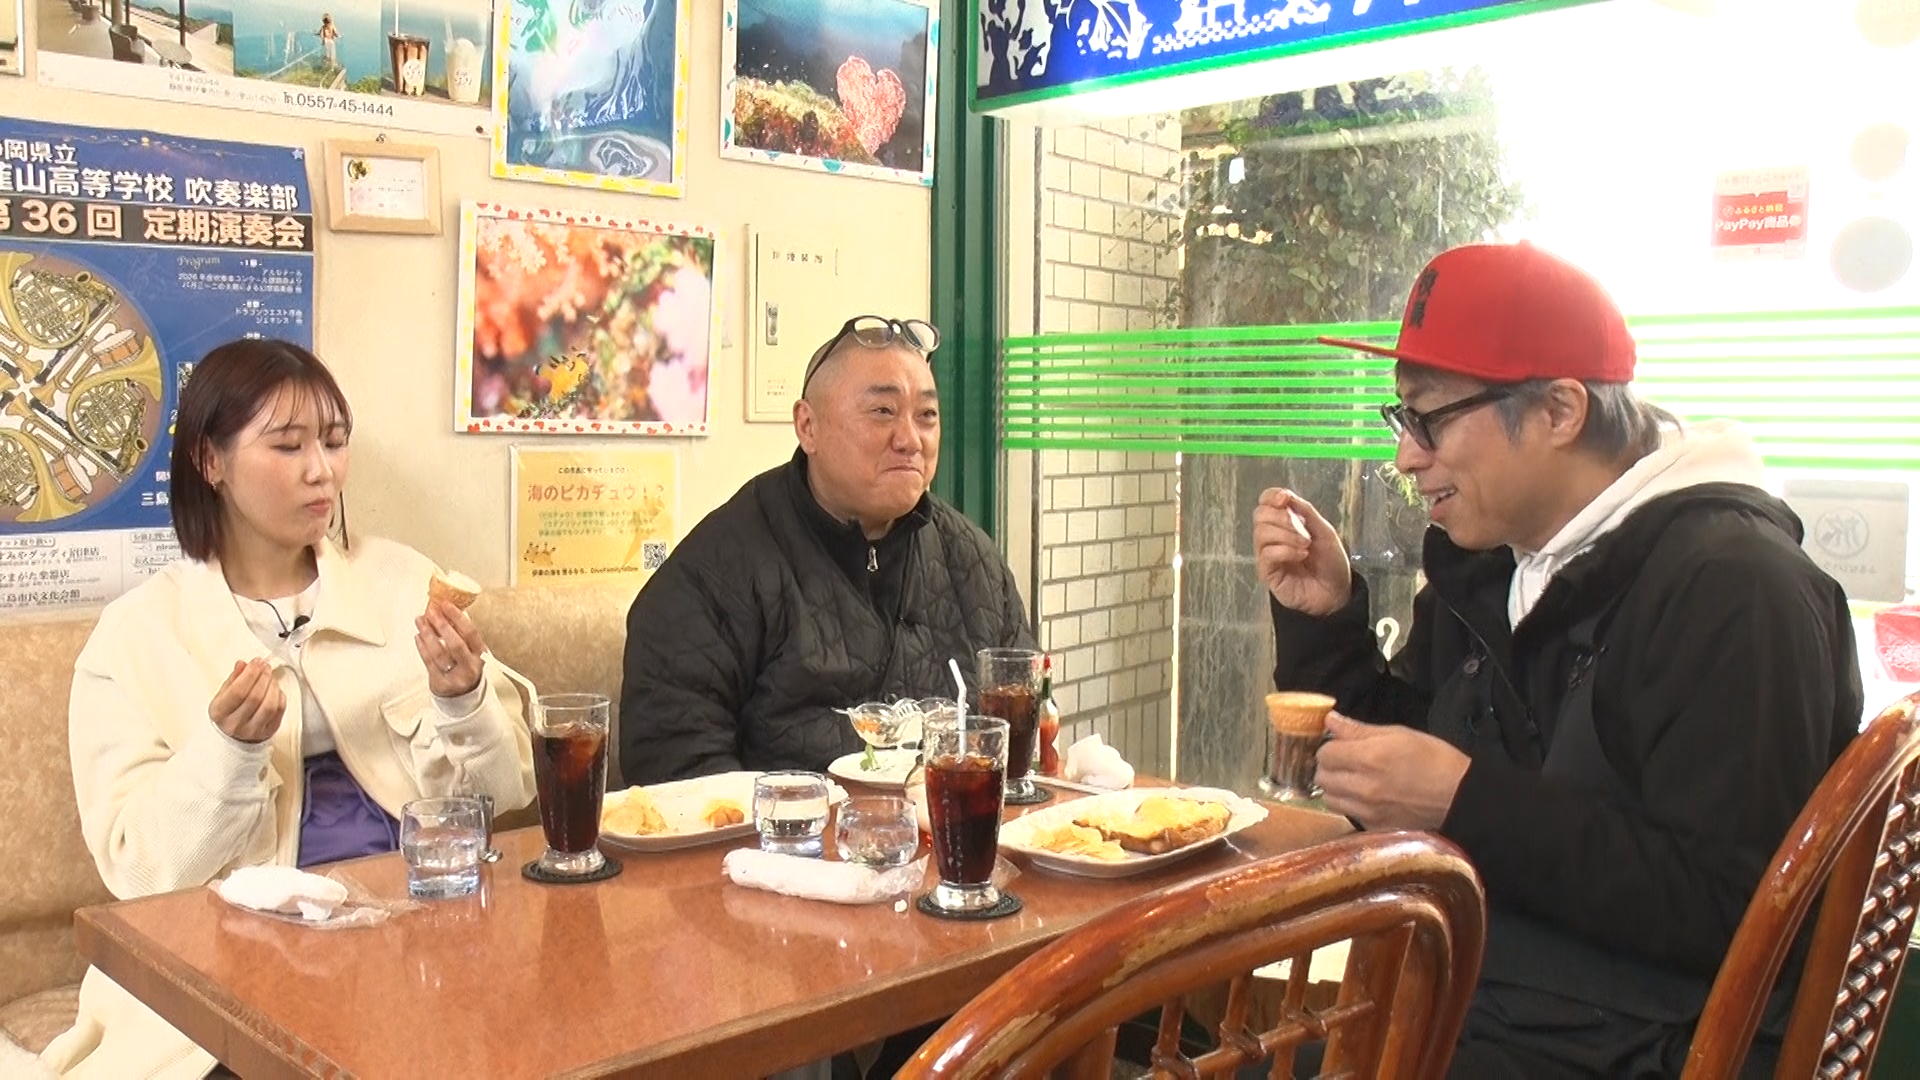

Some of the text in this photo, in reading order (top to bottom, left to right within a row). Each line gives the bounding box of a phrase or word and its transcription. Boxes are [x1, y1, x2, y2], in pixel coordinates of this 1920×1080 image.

[0, 138, 77, 164] 岡県立
[185, 178, 298, 211] 吹奏楽部
[143, 207, 305, 248] 定期演奏会
[1715, 214, 1802, 232] PayPay商品券
[177, 255, 220, 269] Program
